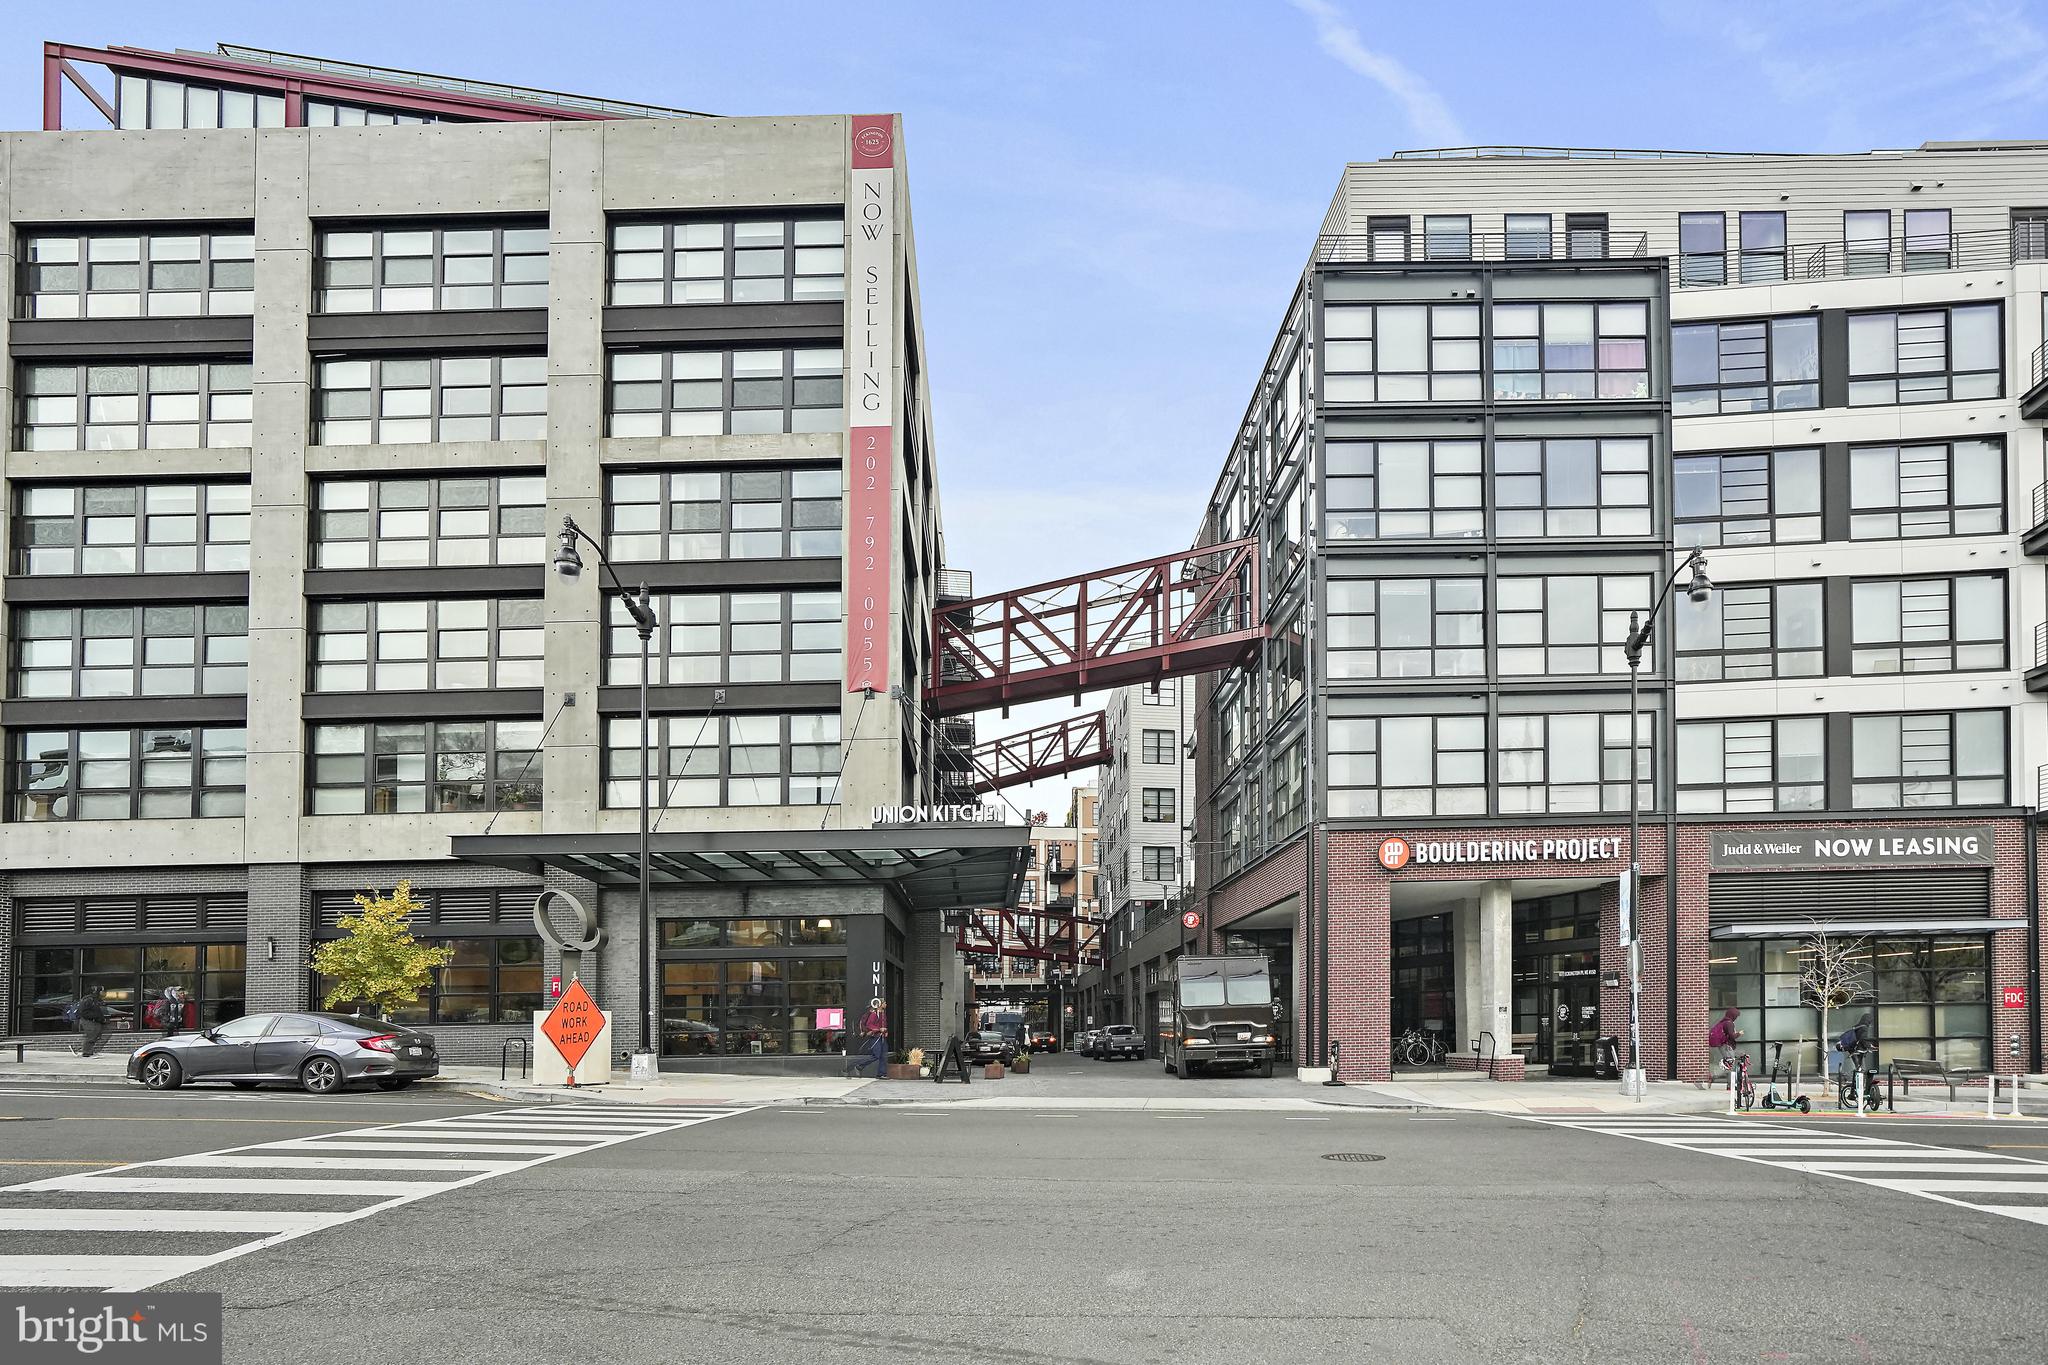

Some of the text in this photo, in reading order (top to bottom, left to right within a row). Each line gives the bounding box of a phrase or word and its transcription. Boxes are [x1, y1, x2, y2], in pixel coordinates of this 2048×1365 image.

[861, 182, 884, 411] NOW SELLING
[871, 804, 1005, 823] UNION KITCHEN
[1415, 837, 1622, 864] BOULDERING PROJECT
[1721, 836, 1979, 857] Judd & Weiler NOW LEASING
[871, 961, 881, 1009] UNIO
[562, 1001, 589, 1013] ROAD
[2004, 992, 2024, 1003] FDC
[561, 1016, 588, 1029] WORK
[559, 1031, 590, 1045] AHEAD
